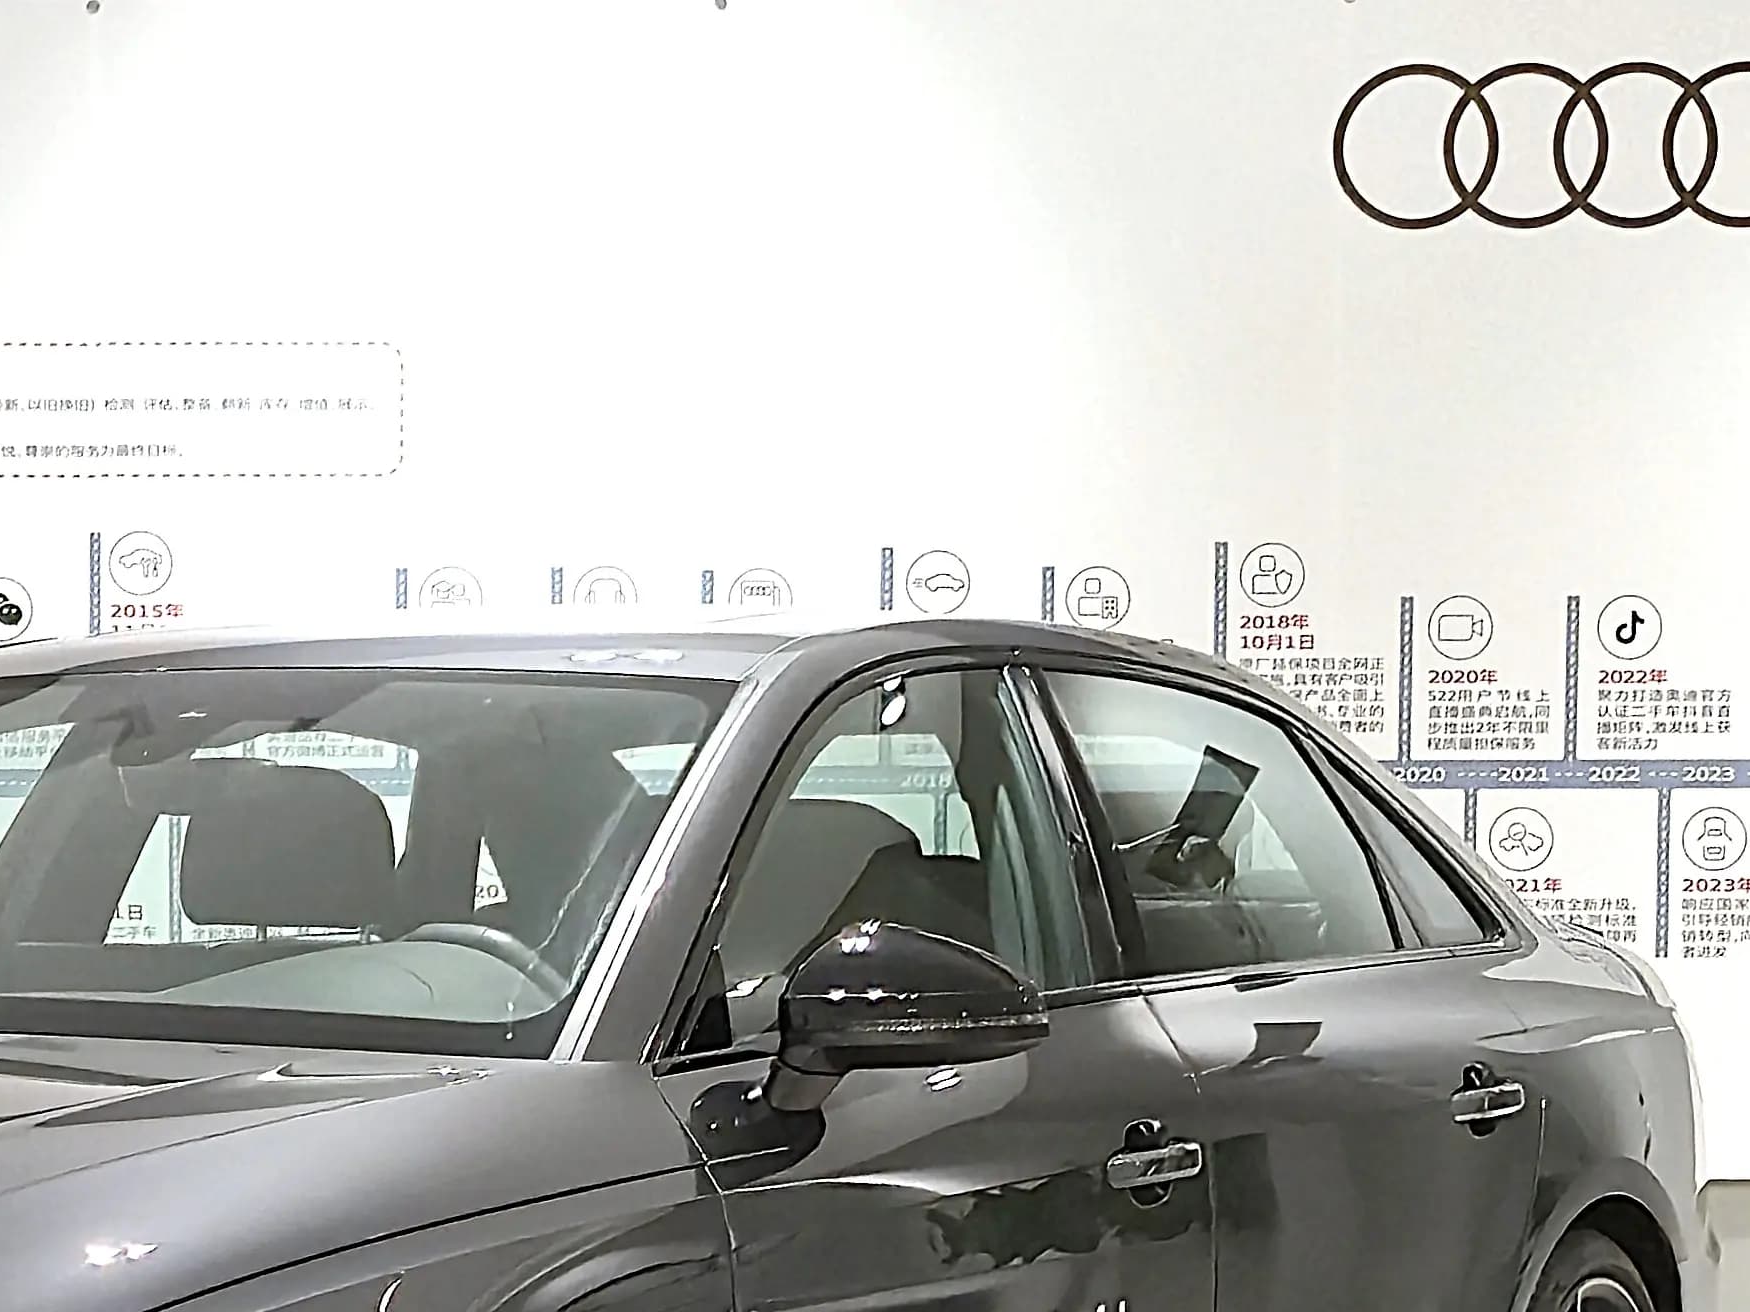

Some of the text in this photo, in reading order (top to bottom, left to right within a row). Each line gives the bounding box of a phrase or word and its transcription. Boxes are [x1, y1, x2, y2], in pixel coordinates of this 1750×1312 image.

[110, 603, 184, 618] 2015年
[1240, 614, 1309, 630] 2018年
[1240, 635, 1315, 650] 10月1日
[1428, 669, 1498, 685] 2020年
[1598, 669, 1668, 685] 2022年
[1395, 767, 1447, 783] 2020
[1497, 767, 1550, 783] 2021
[1588, 766, 1641, 782] 2022
[1682, 766, 1736, 782] 2023
[1505, 878, 1562, 893] 021年
